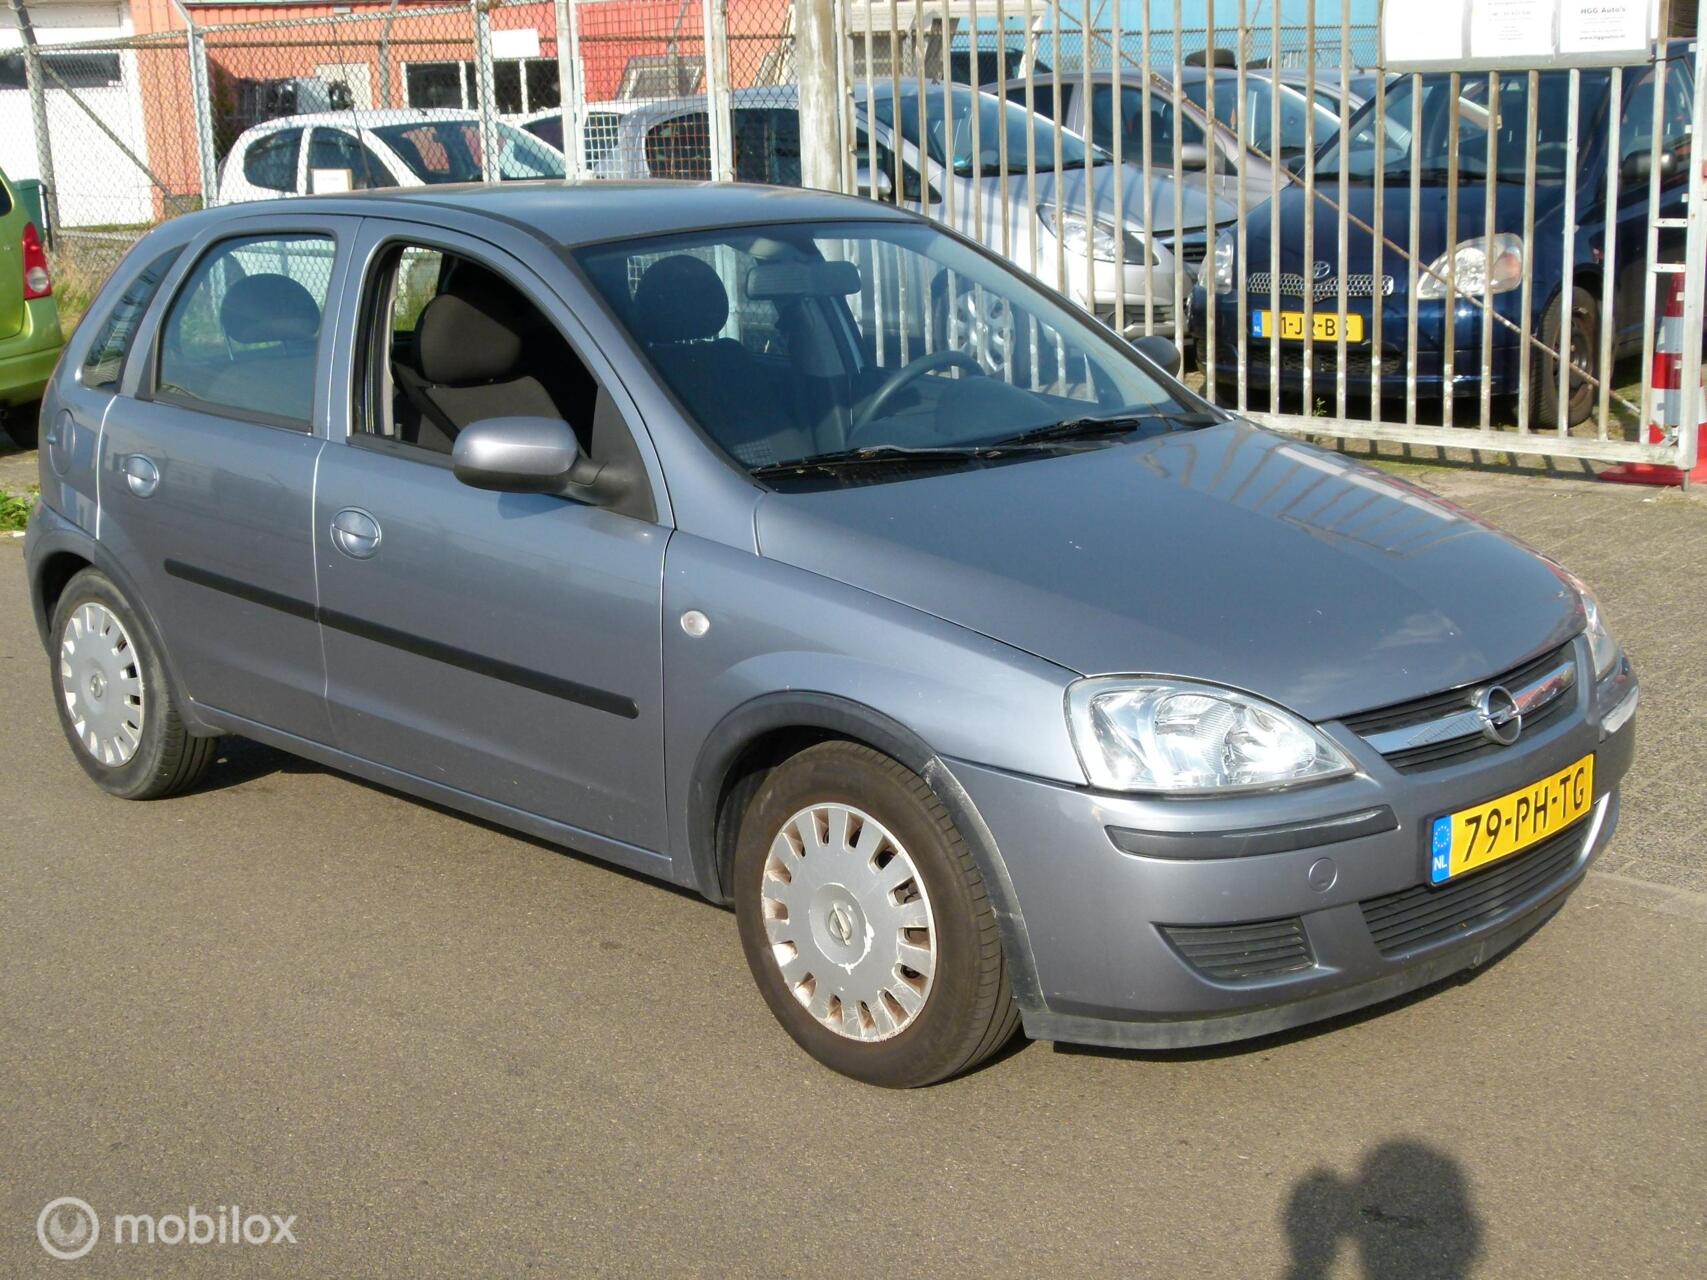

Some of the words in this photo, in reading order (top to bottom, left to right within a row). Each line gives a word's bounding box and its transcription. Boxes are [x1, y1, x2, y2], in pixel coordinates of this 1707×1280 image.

[1580, 7, 1599, 15] HGG
[1601, 6, 1627, 14] Auto's
[1463, 766, 1584, 863] 79-PH-TG
[1433, 854, 1448, 871] NL
